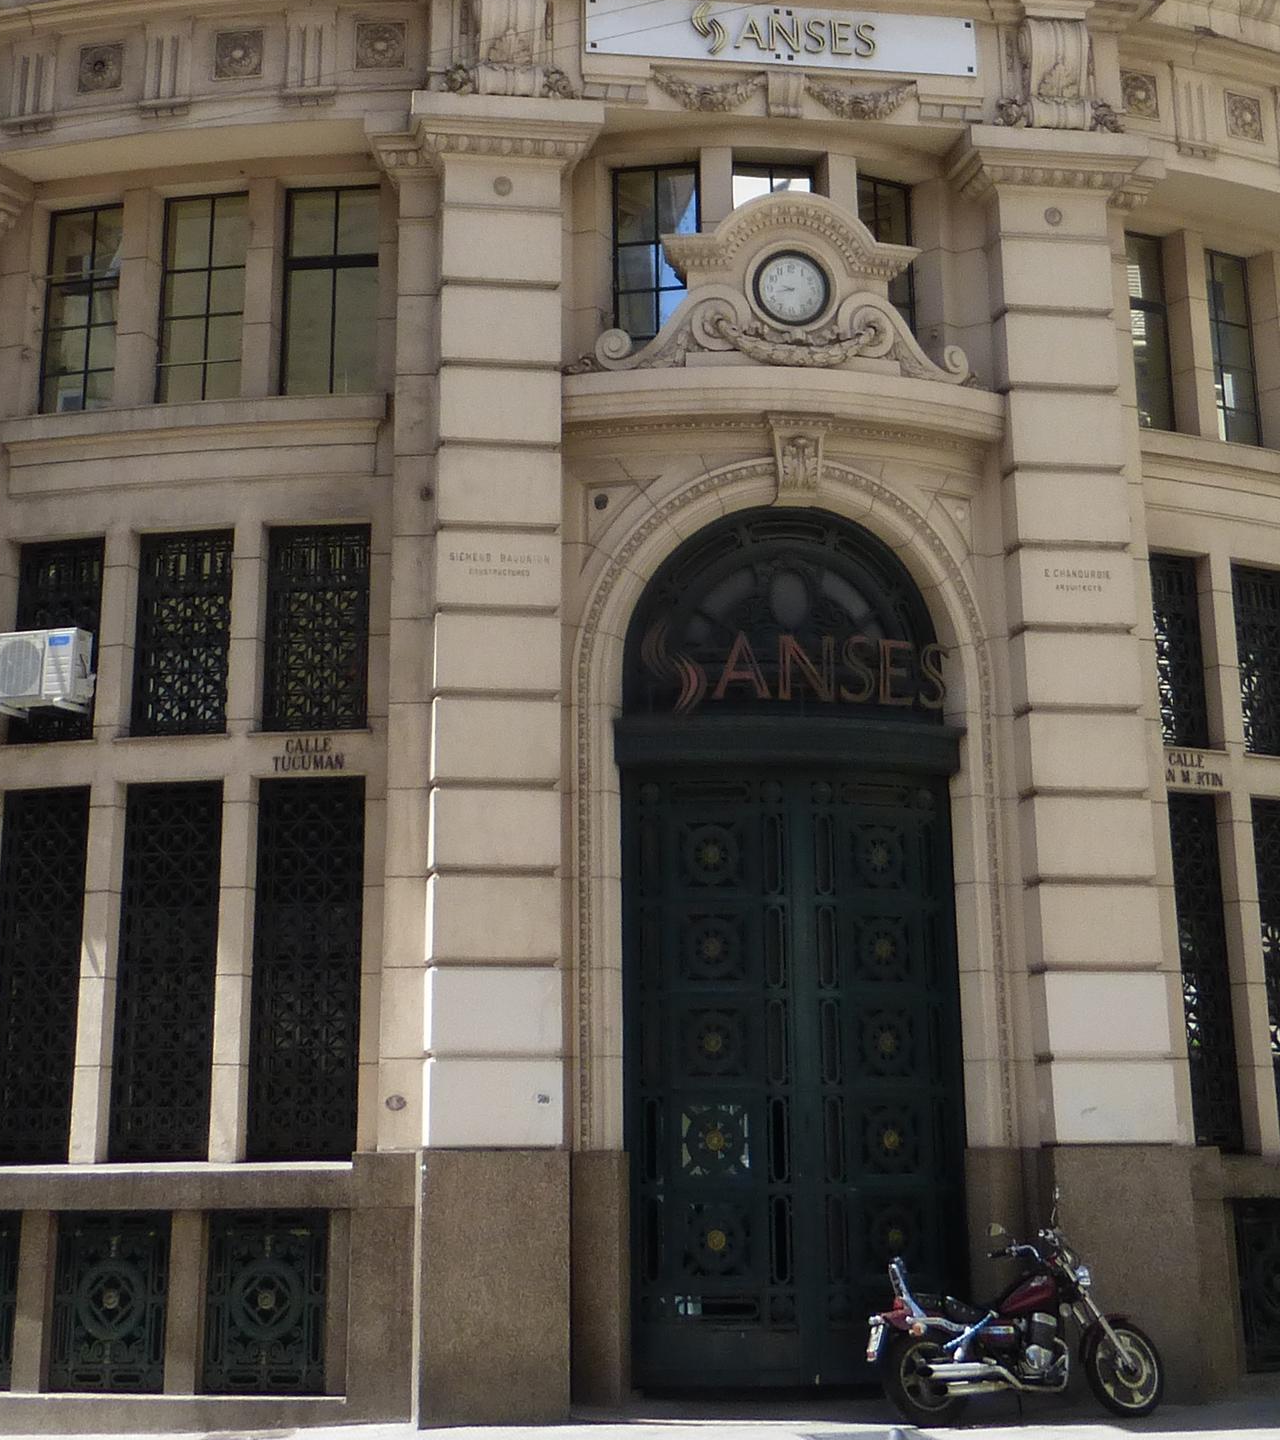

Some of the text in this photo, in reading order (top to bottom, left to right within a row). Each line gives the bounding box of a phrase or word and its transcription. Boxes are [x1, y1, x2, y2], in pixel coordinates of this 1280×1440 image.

[734, 13, 877, 58] ANSES
[712, 631, 950, 709] ANSES
[285, 737, 333, 754] CALLE
[272, 753, 345, 771] TUCUMAN
[1168, 753, 1205, 769] CALLE
[1181, 770, 1224, 787] MRTIN
